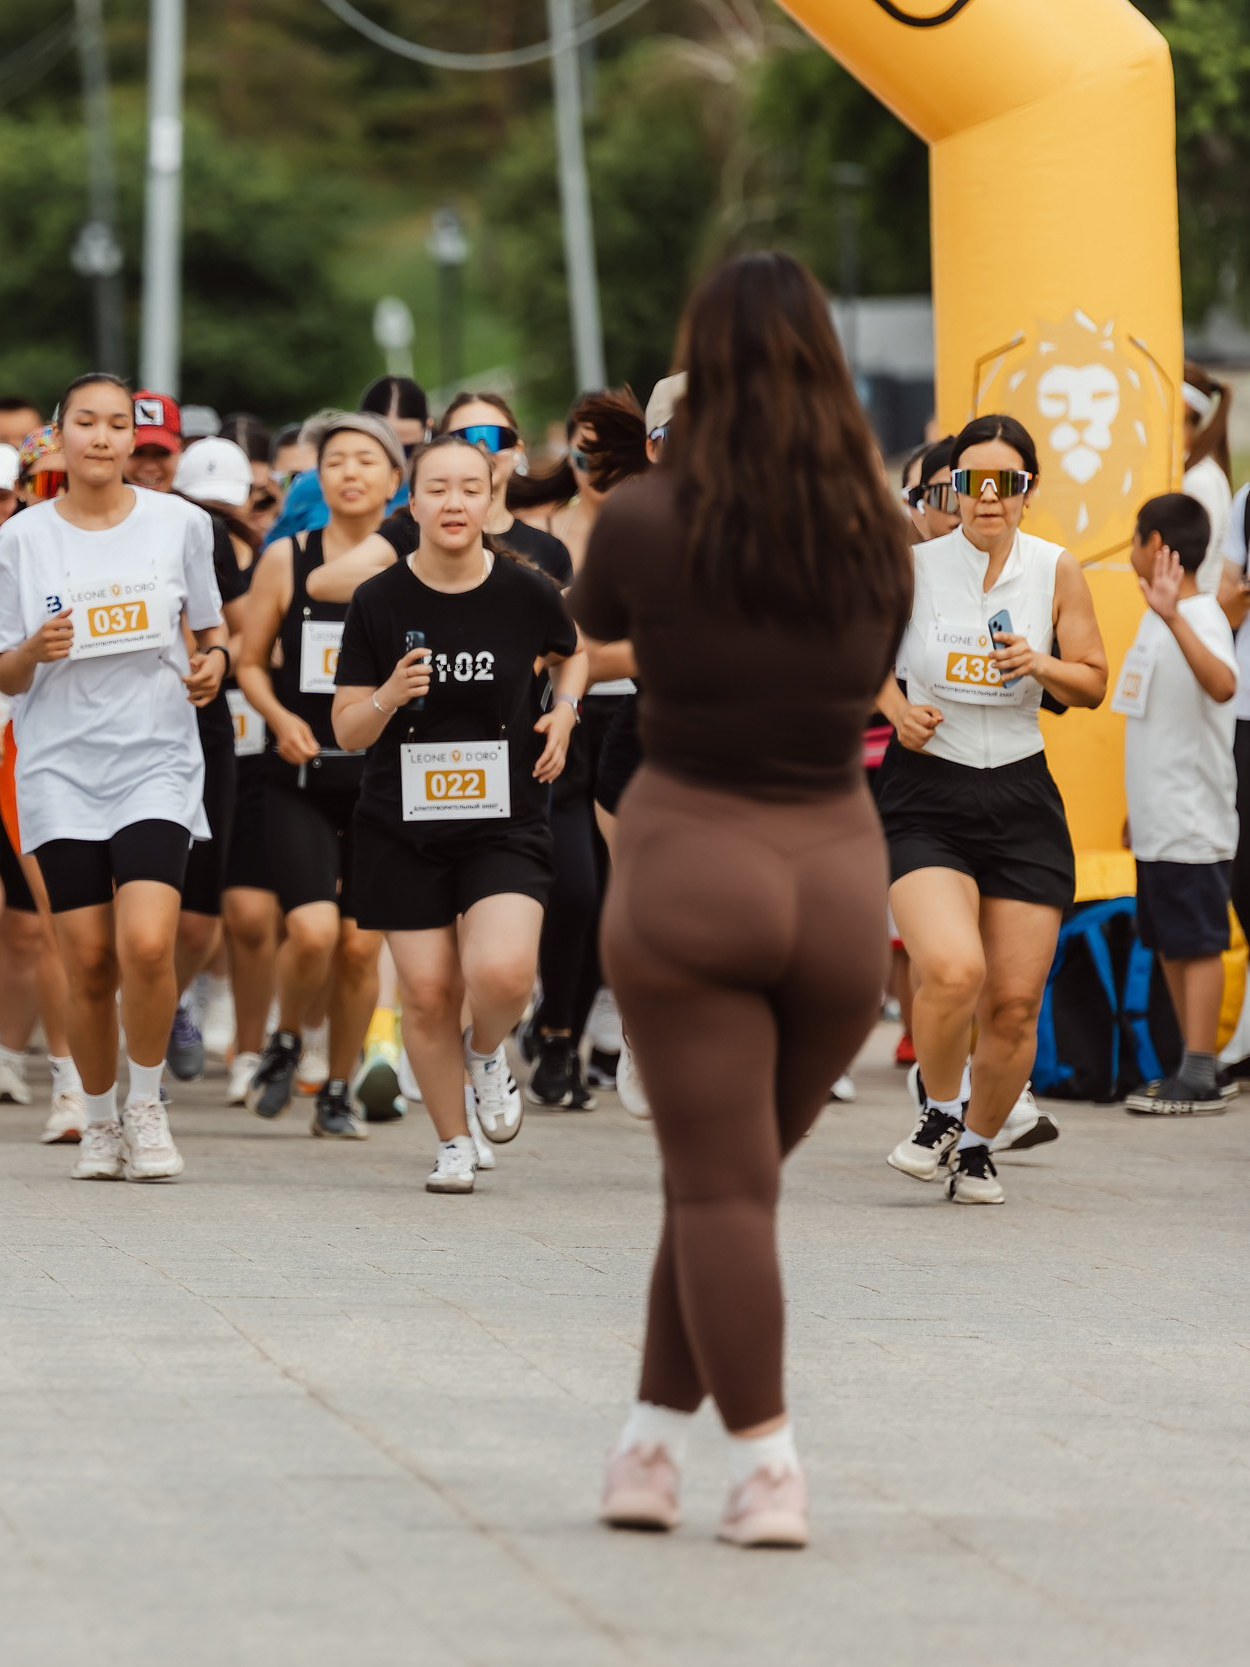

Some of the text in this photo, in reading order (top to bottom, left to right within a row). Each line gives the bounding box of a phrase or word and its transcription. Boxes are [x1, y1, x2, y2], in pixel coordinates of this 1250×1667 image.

[70, 582, 156, 603] LEONE DORO
[93, 604, 141, 634] 037
[937, 633, 973, 647] LEONE
[951, 655, 1002, 684] 438
[410, 751, 498, 764] LEONE DORO
[430, 771, 481, 798] 022
